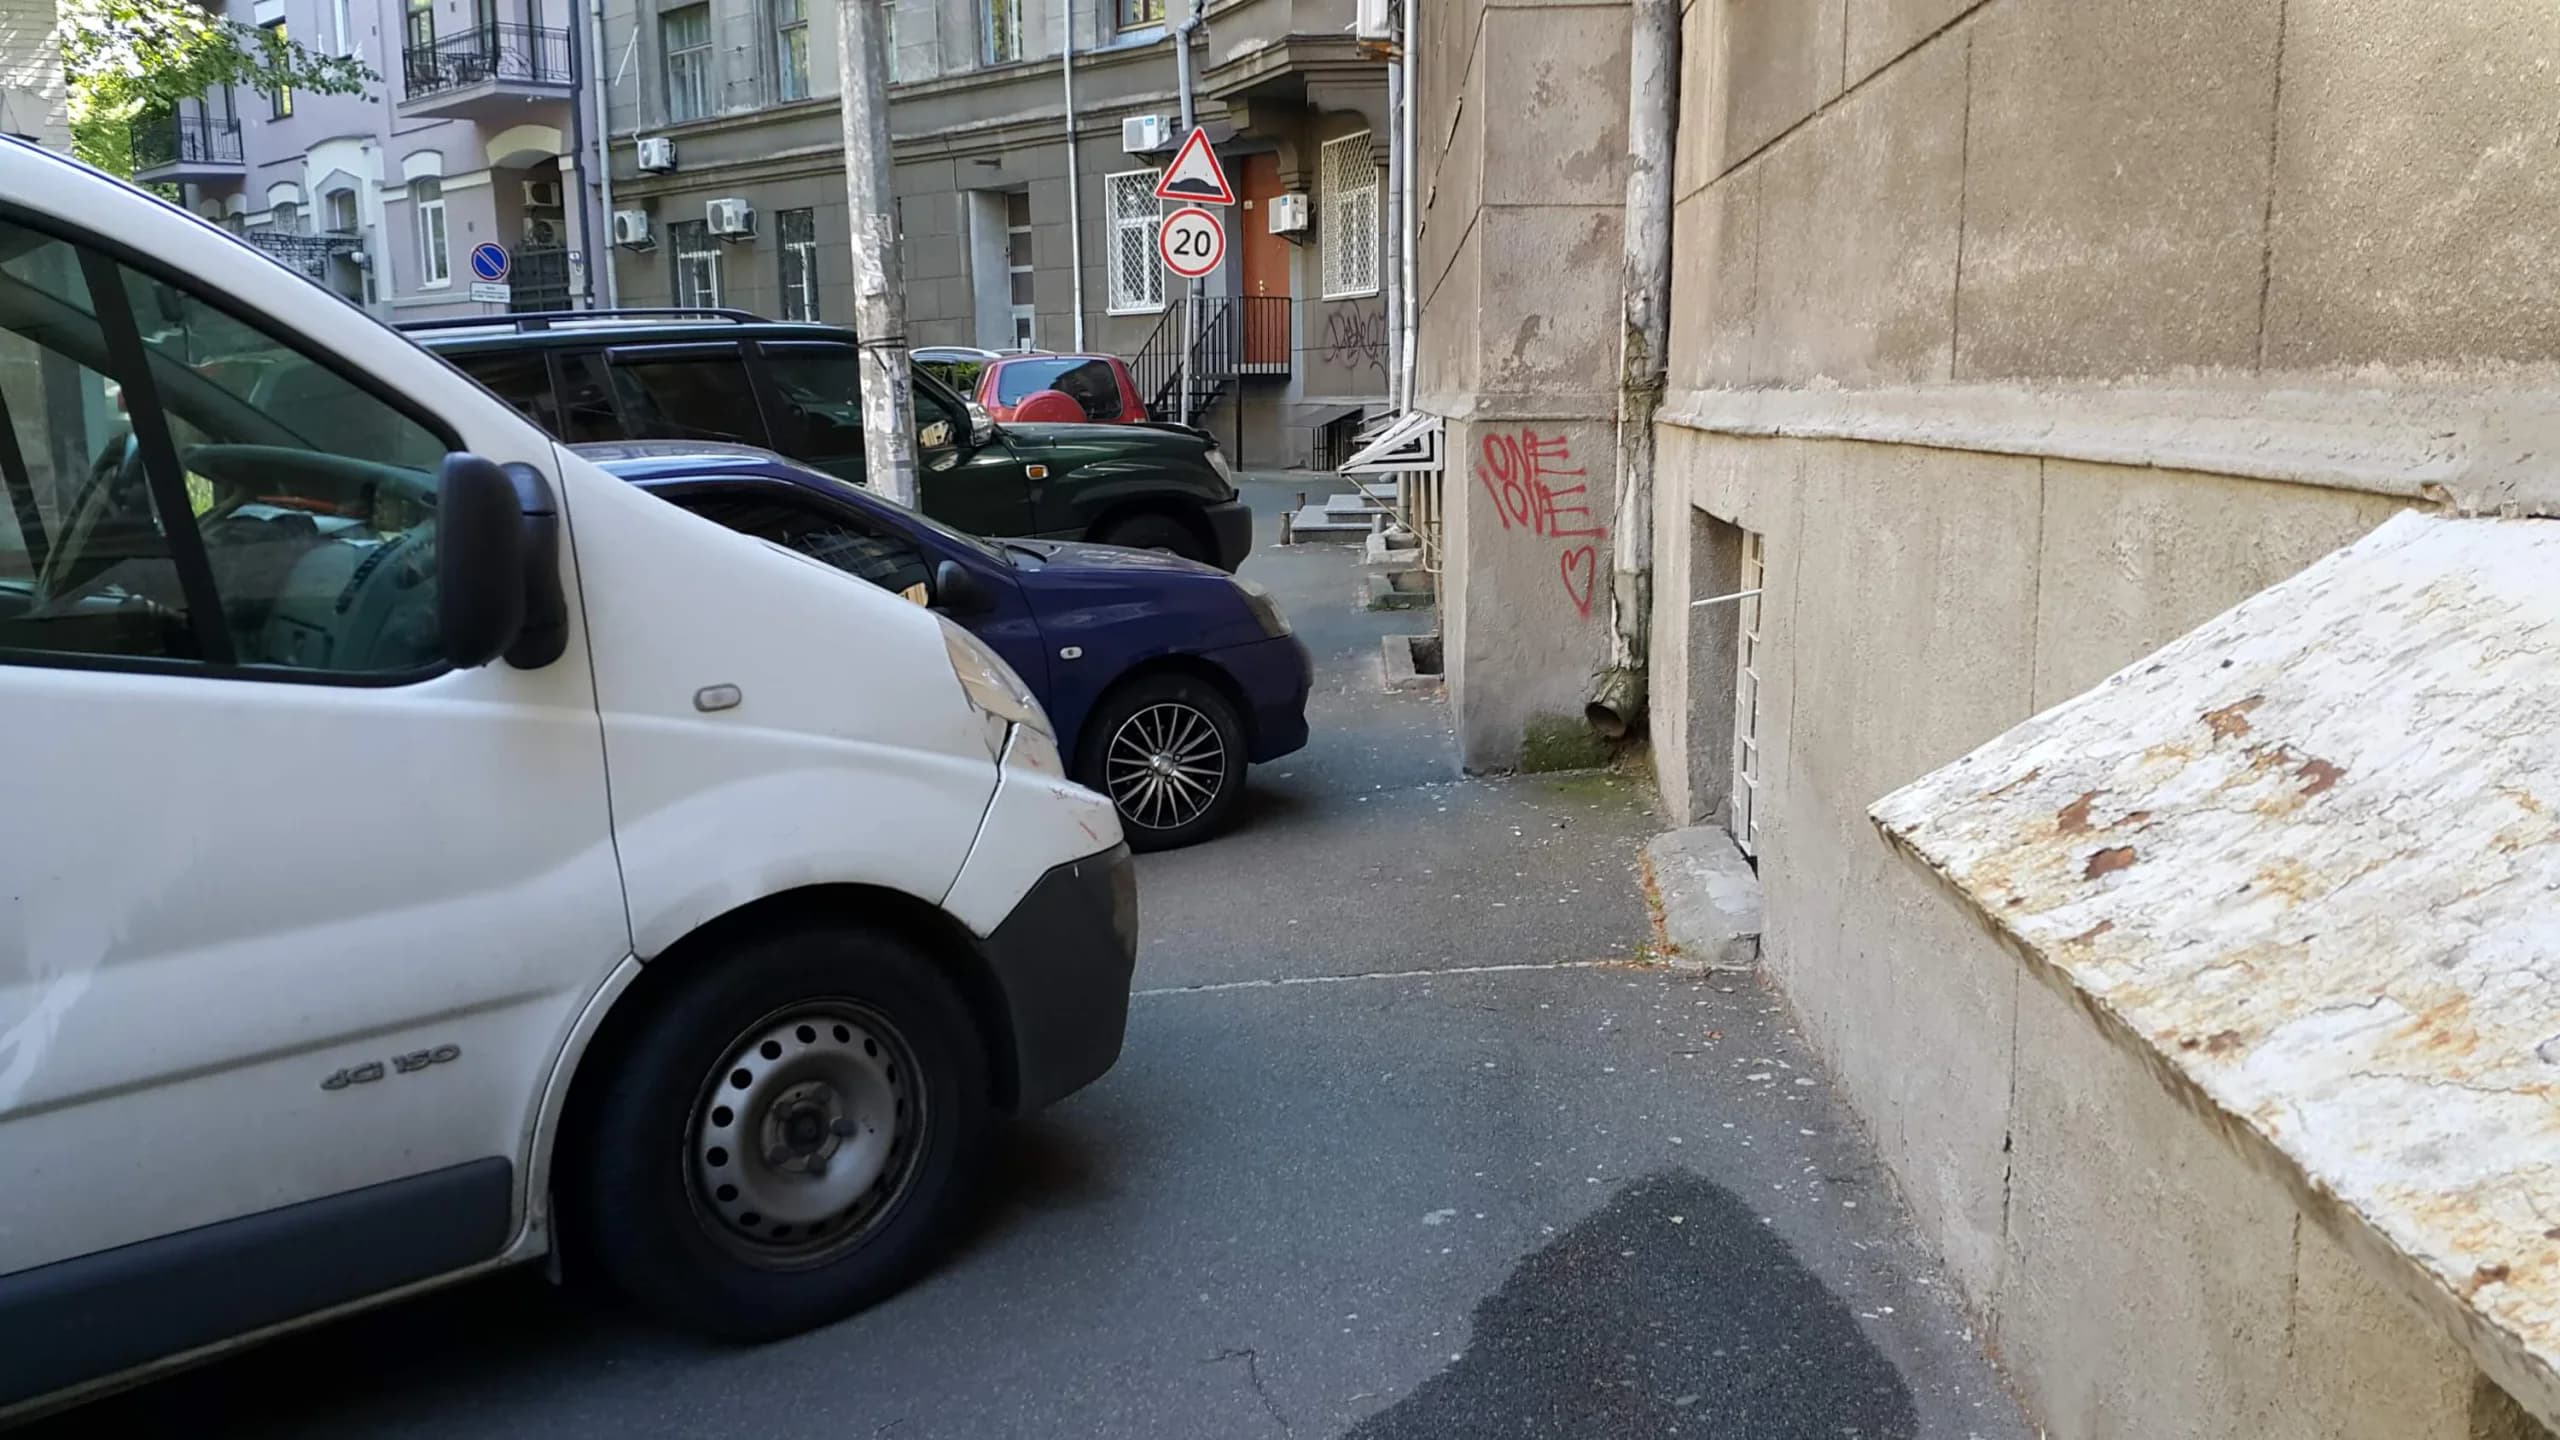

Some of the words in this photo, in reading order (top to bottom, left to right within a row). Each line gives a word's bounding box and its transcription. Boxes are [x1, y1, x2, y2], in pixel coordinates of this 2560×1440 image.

[1173, 228, 1212, 257] 20
[1482, 426, 1587, 484] ONE
[391, 1043, 461, 1075] 150
